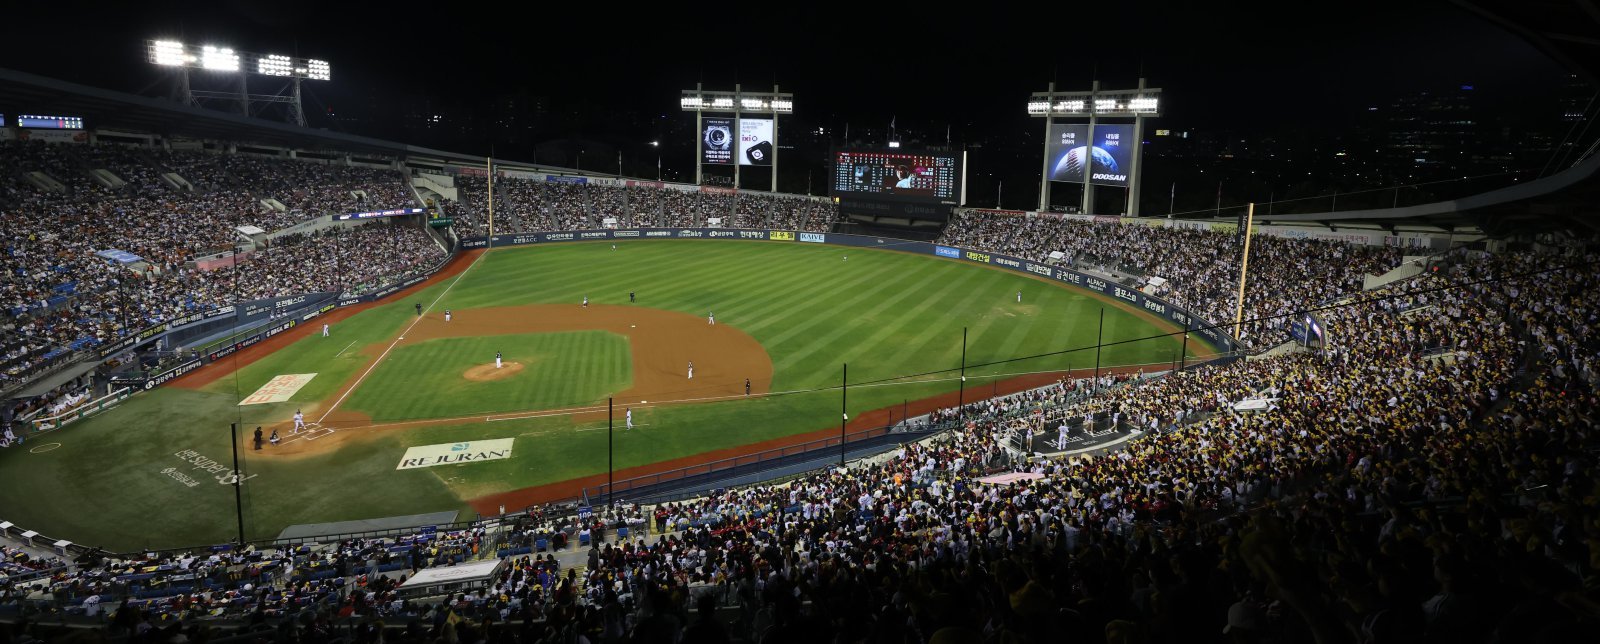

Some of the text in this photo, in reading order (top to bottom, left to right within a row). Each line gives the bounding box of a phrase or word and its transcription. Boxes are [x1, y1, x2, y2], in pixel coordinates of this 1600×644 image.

[1092, 173, 1127, 182] DOOSAN
[739, 231, 765, 239] 현대해상
[801, 233, 824, 241] KAIVE
[966, 251, 991, 263] 대방건설
[1056, 270, 1080, 284] 금천미트
[1086, 277, 1107, 289] ALPACA
[275, 296, 306, 309] 포천힐스CC
[340, 299, 360, 307] ALPACA
[401, 449, 505, 467] REJURAN
